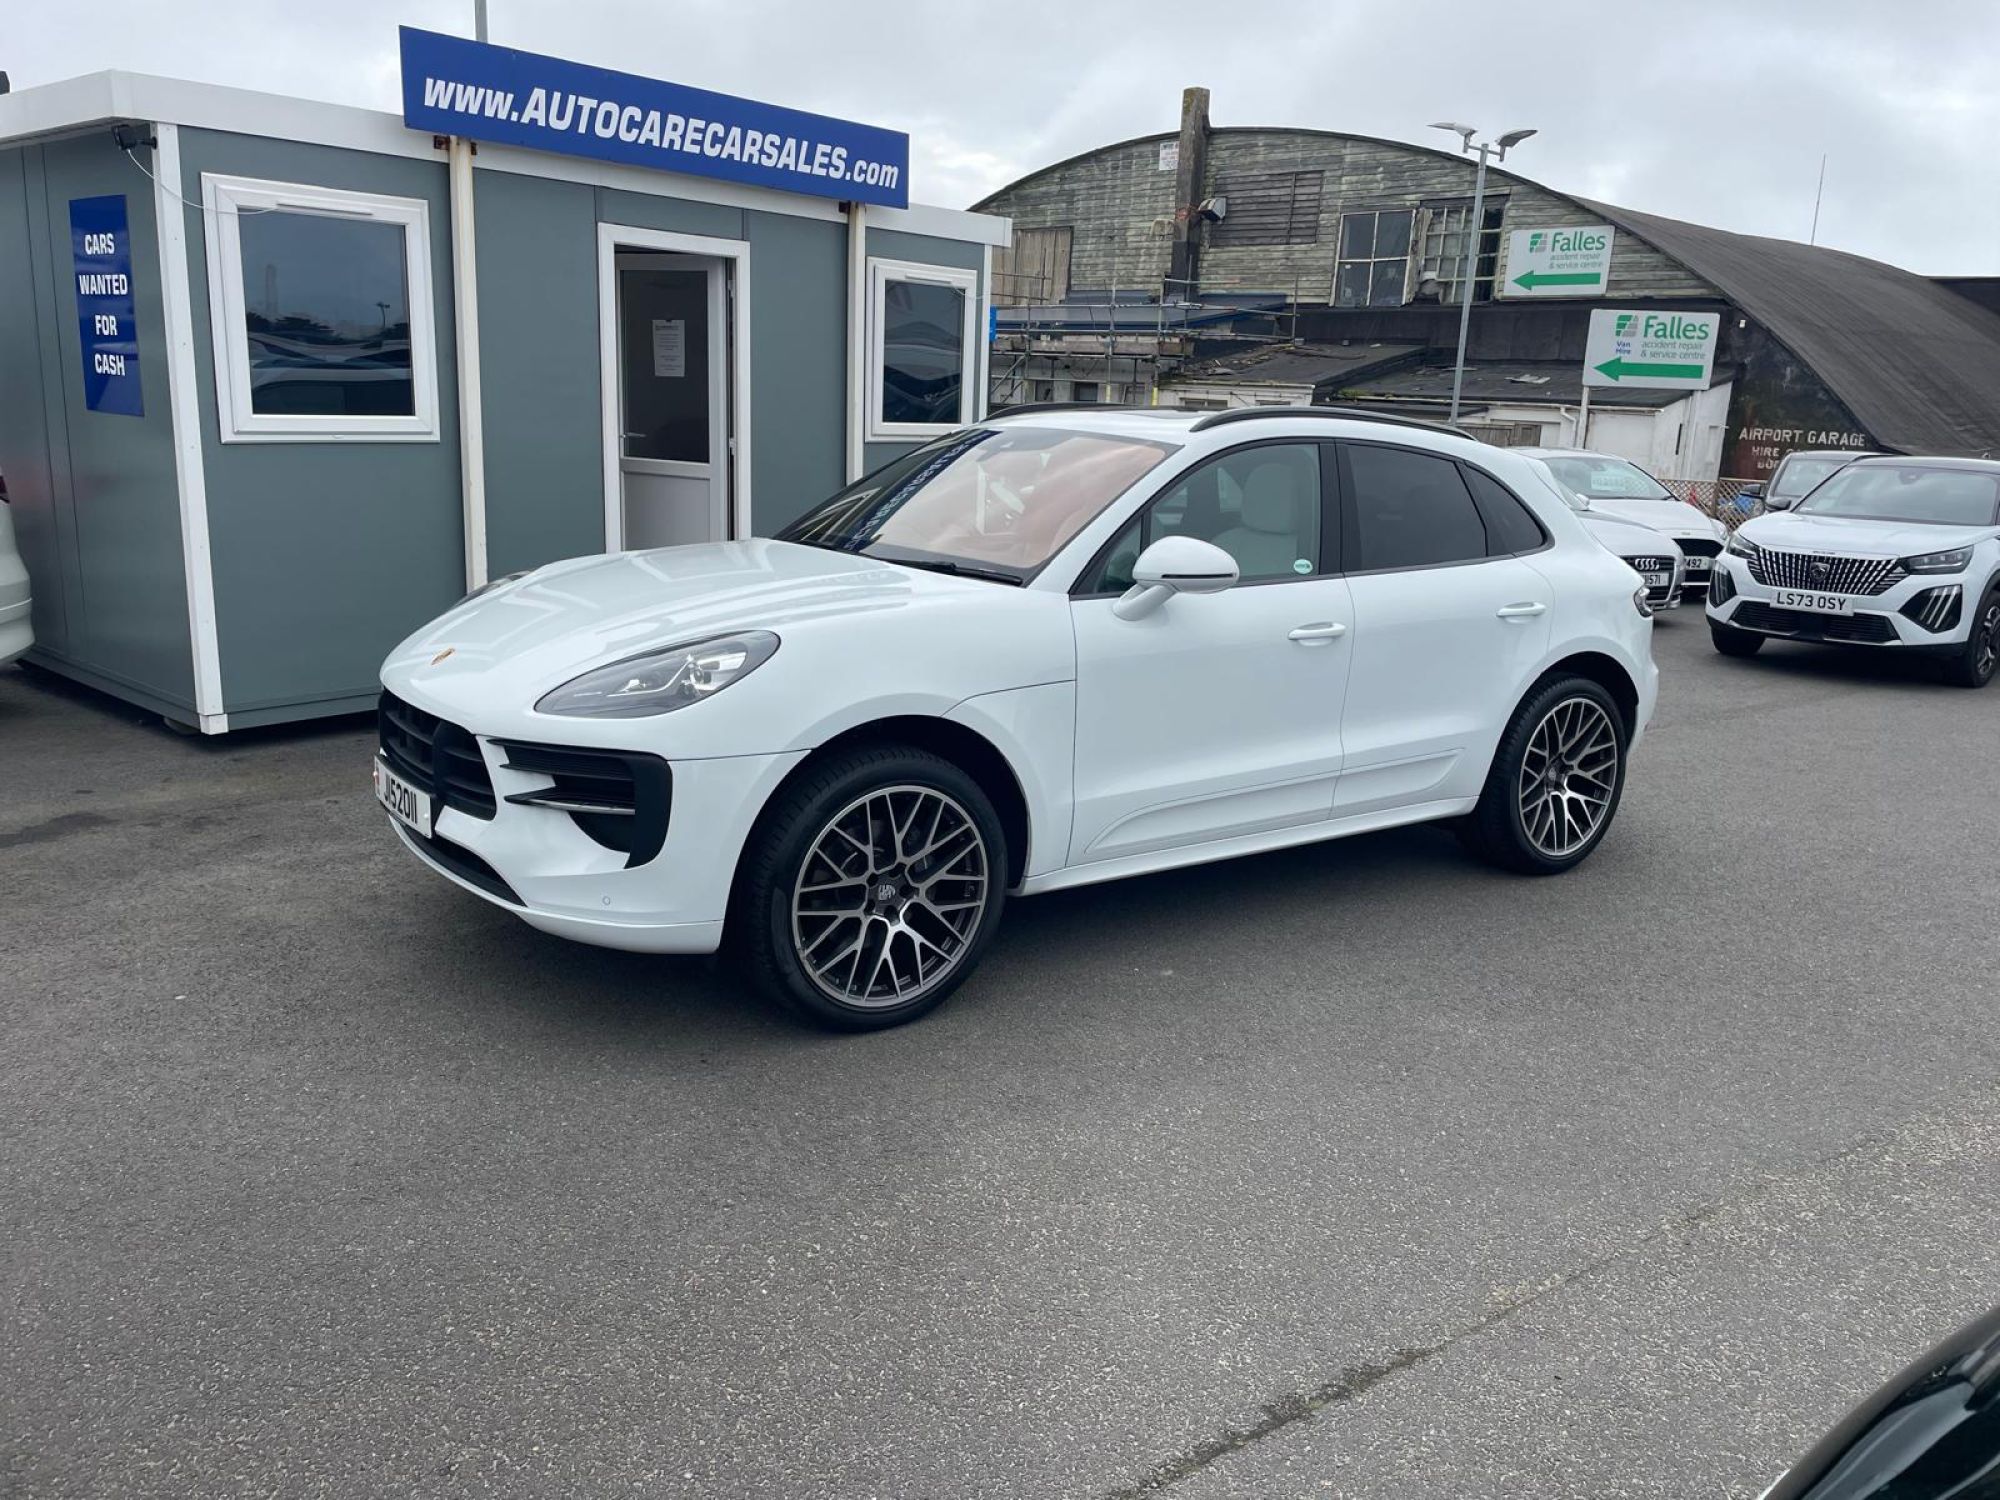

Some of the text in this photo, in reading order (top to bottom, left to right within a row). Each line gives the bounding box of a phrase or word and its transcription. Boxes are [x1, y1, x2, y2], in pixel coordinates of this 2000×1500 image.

[424, 77, 899, 190] www.AUTOCARECARSALES.com
[85, 234, 115, 255] CARS
[1551, 231, 1605, 252] Falles
[79, 274, 128, 295] WANTED
[95, 315, 117, 336] FOR
[1643, 315, 1709, 340] Falles
[1641, 340, 1703, 351] accident repair
[1641, 350, 1647, 358] &
[1680, 351, 1705, 359] centre
[94, 354, 126, 376] CASH
[1739, 427, 1865, 447] AIRPORT GARAGE
[1752, 446, 1780, 457] HIRE
[1777, 592, 1814, 607] LS73
